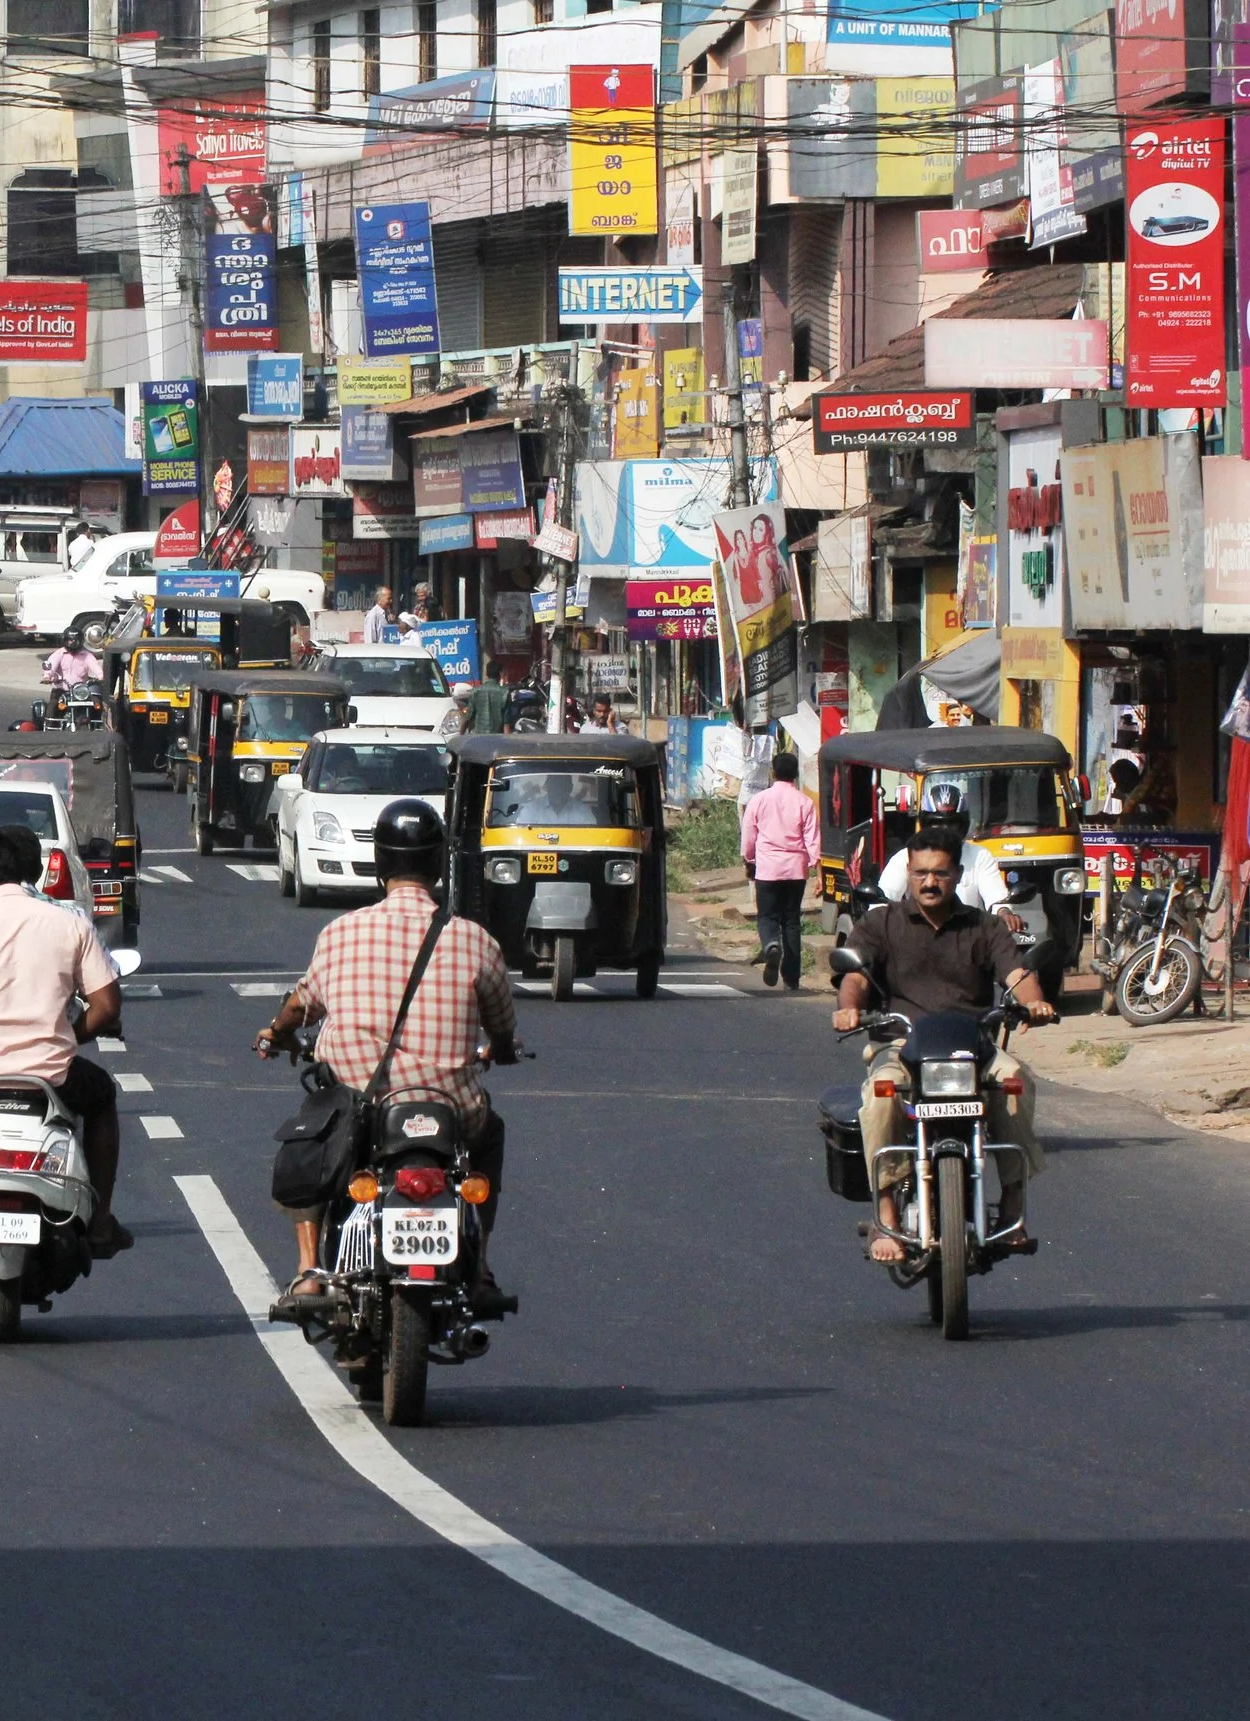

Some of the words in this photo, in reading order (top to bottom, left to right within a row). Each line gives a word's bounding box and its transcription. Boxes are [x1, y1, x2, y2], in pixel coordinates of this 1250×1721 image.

[836, 22, 845, 33] A
[848, 23, 876, 34] UNIT
[879, 24, 895, 35] OF
[899, 24, 951, 37] MANNAR
[196, 129, 226, 161] Safiya
[1161, 136, 1211, 155] airtel
[1161, 158, 1195, 169] digital
[1197, 158, 1211, 168] TV
[591, 212, 638, 227] ബാങ്ക്
[1149, 272, 1200, 290] S.M
[561, 276, 691, 313] INTERNET
[1138, 294, 1212, 302] Communications
[17, 315, 34, 333] of
[37, 315, 75, 333] India
[1185, 319, 1211, 327] 222218
[152, 383, 190, 394] ALICKA
[1139, 384, 1154, 393] airtel
[825, 399, 961, 424] ഫാഷൻക്ലബ്ബ്
[831, 431, 958, 446] Ph:9447624198
[150, 469, 196, 481] SERVICE
[644, 478, 693, 486] milma
[593, 765, 624, 777] Aneesh
[537, 833, 559, 843] ape
[532, 855, 555, 863] KL.50
[531, 863, 555, 872] 6797
[1019, 935, 1037, 943] 786
[10, 1217, 24, 1228] 09
[395, 1220, 447, 1232] KL.07.D
[2, 1229, 28, 1239] 7669
[392, 1236, 450, 1255] 2909
